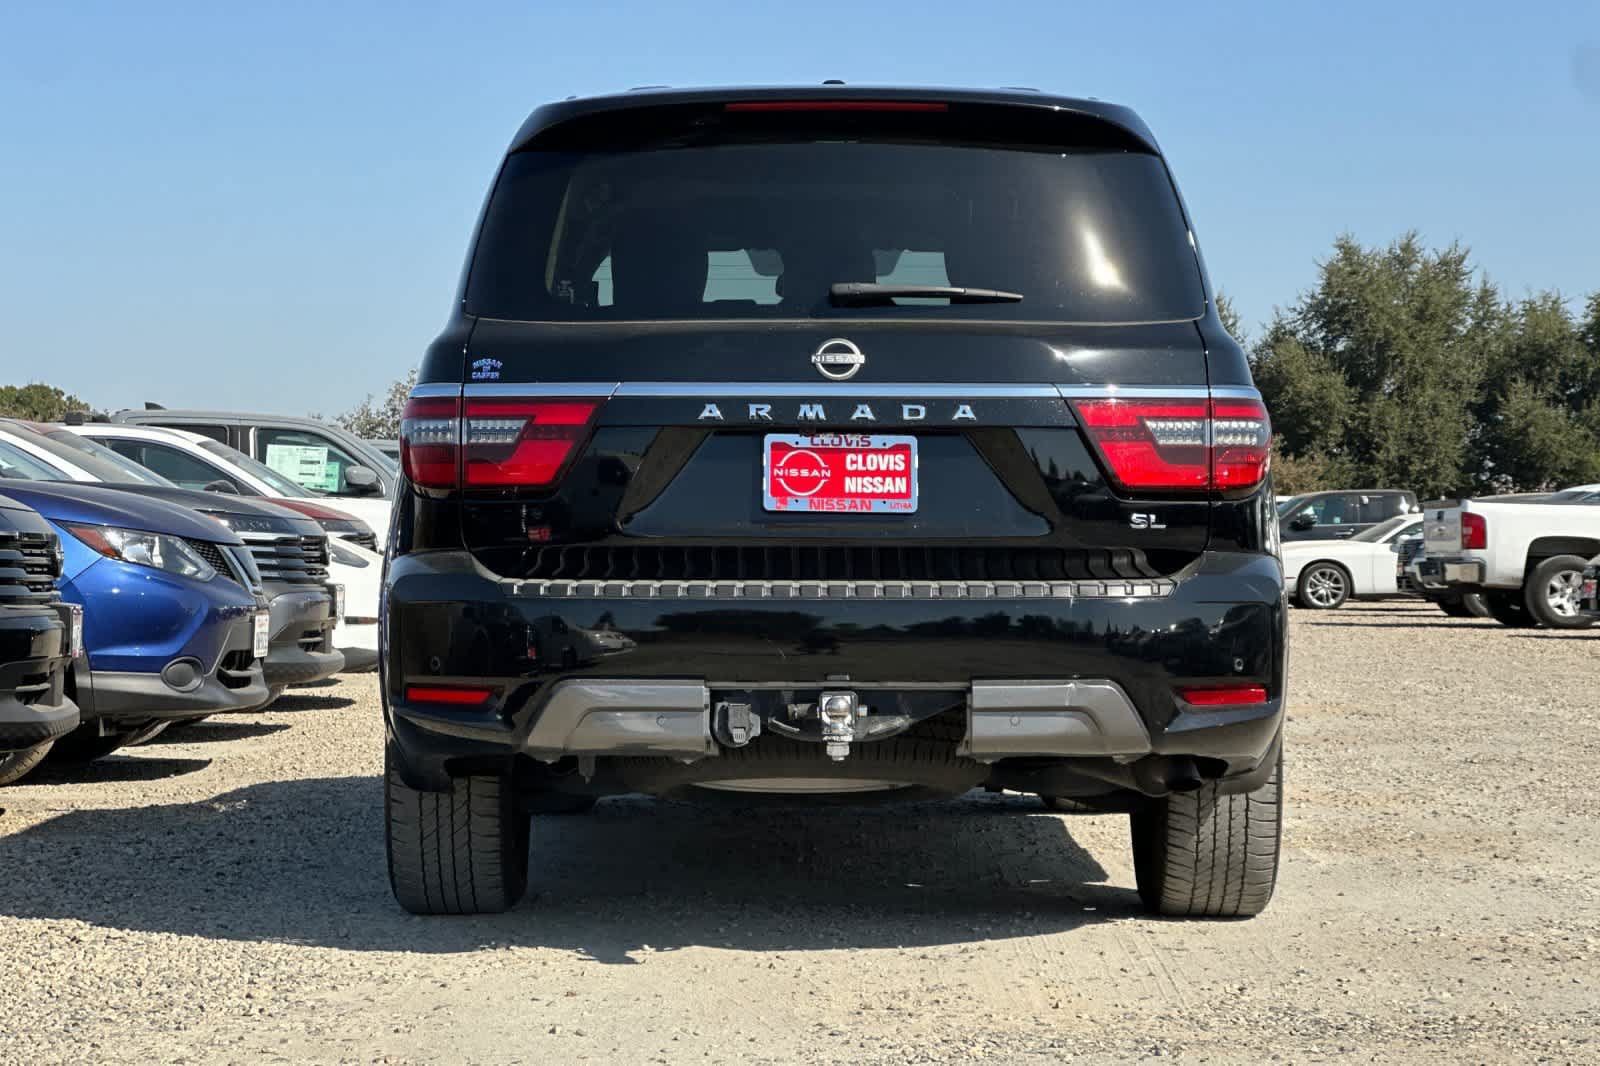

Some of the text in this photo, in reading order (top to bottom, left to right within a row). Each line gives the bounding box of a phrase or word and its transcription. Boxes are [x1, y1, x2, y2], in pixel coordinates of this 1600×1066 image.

[811, 354, 865, 363] NISSAN
[697, 403, 977, 421] ARMADA
[810, 434, 872, 448] CLOVIS
[845, 453, 906, 471] CLOVIS
[773, 468, 831, 478] NISSAN
[844, 476, 907, 494] NISSAN
[808, 499, 873, 511] NISSAN
[1130, 513, 1167, 529] SL
